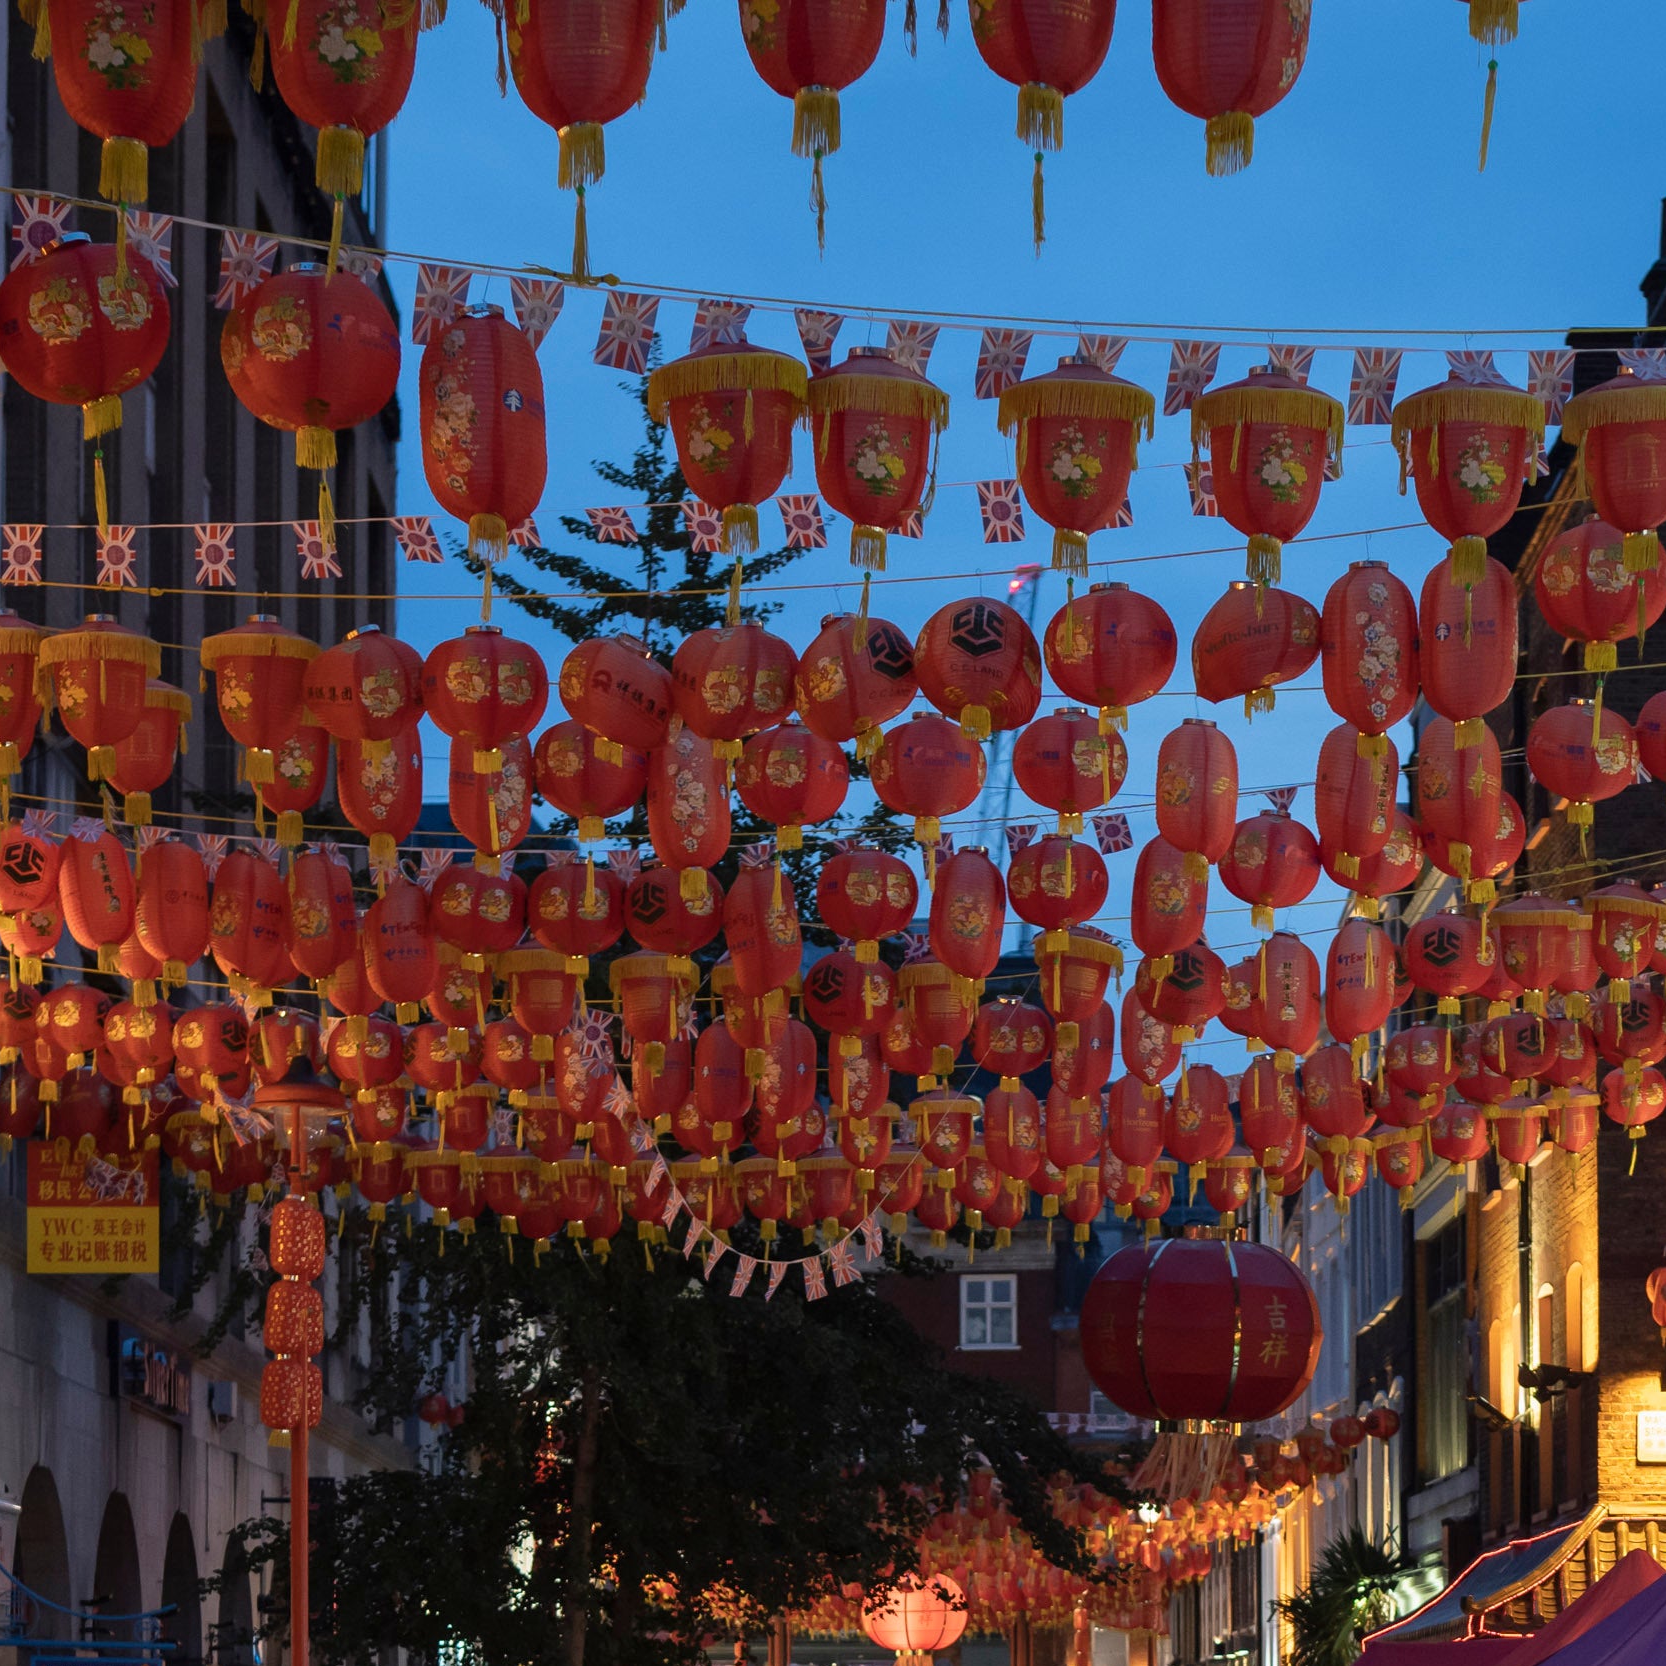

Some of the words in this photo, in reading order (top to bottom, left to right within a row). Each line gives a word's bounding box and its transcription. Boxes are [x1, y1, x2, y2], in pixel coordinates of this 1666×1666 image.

[40, 1240, 148, 1263] 专业记账报税
[1259, 1295, 1289, 1369] 吉祥
